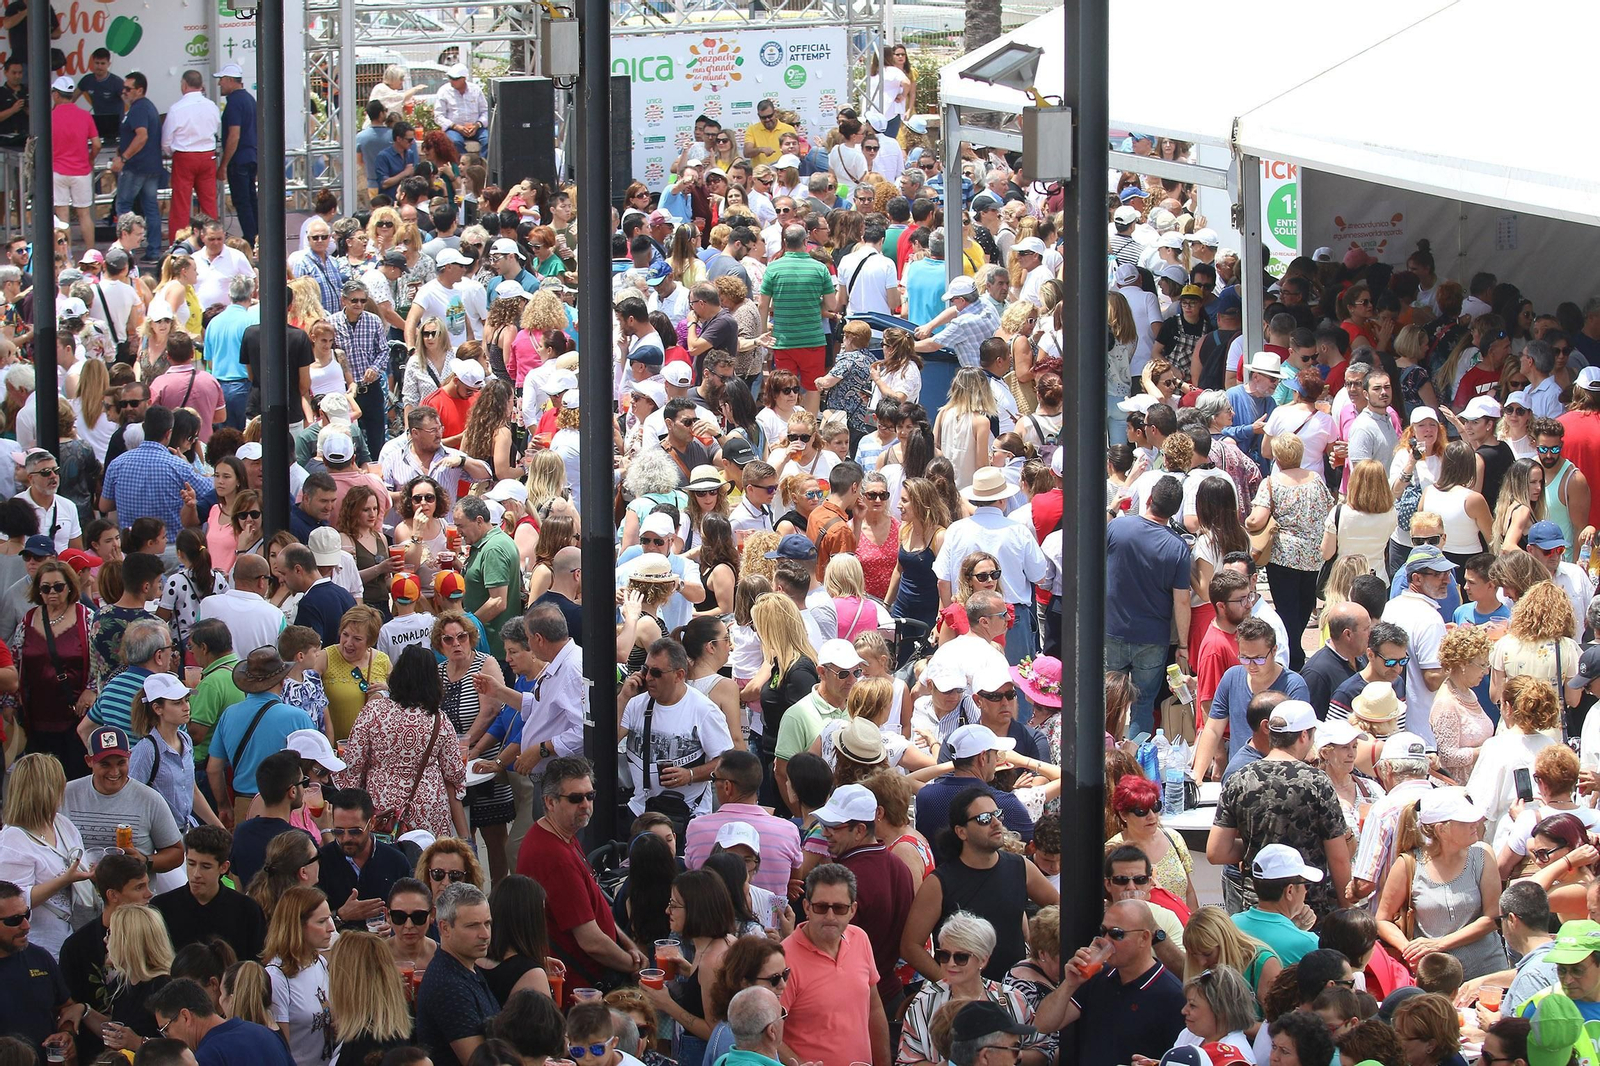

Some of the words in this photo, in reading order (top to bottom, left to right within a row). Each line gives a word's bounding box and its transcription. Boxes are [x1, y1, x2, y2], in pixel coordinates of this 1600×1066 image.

[789, 44, 831, 53] OFFICIAL
[789, 53, 831, 62] ATTEMPT
[611, 56, 674, 82] nica
[787, 69, 795, 80] 9
[1333, 229, 1404, 240] #guinnessworldrecords
[391, 627, 429, 645] RONALDO
